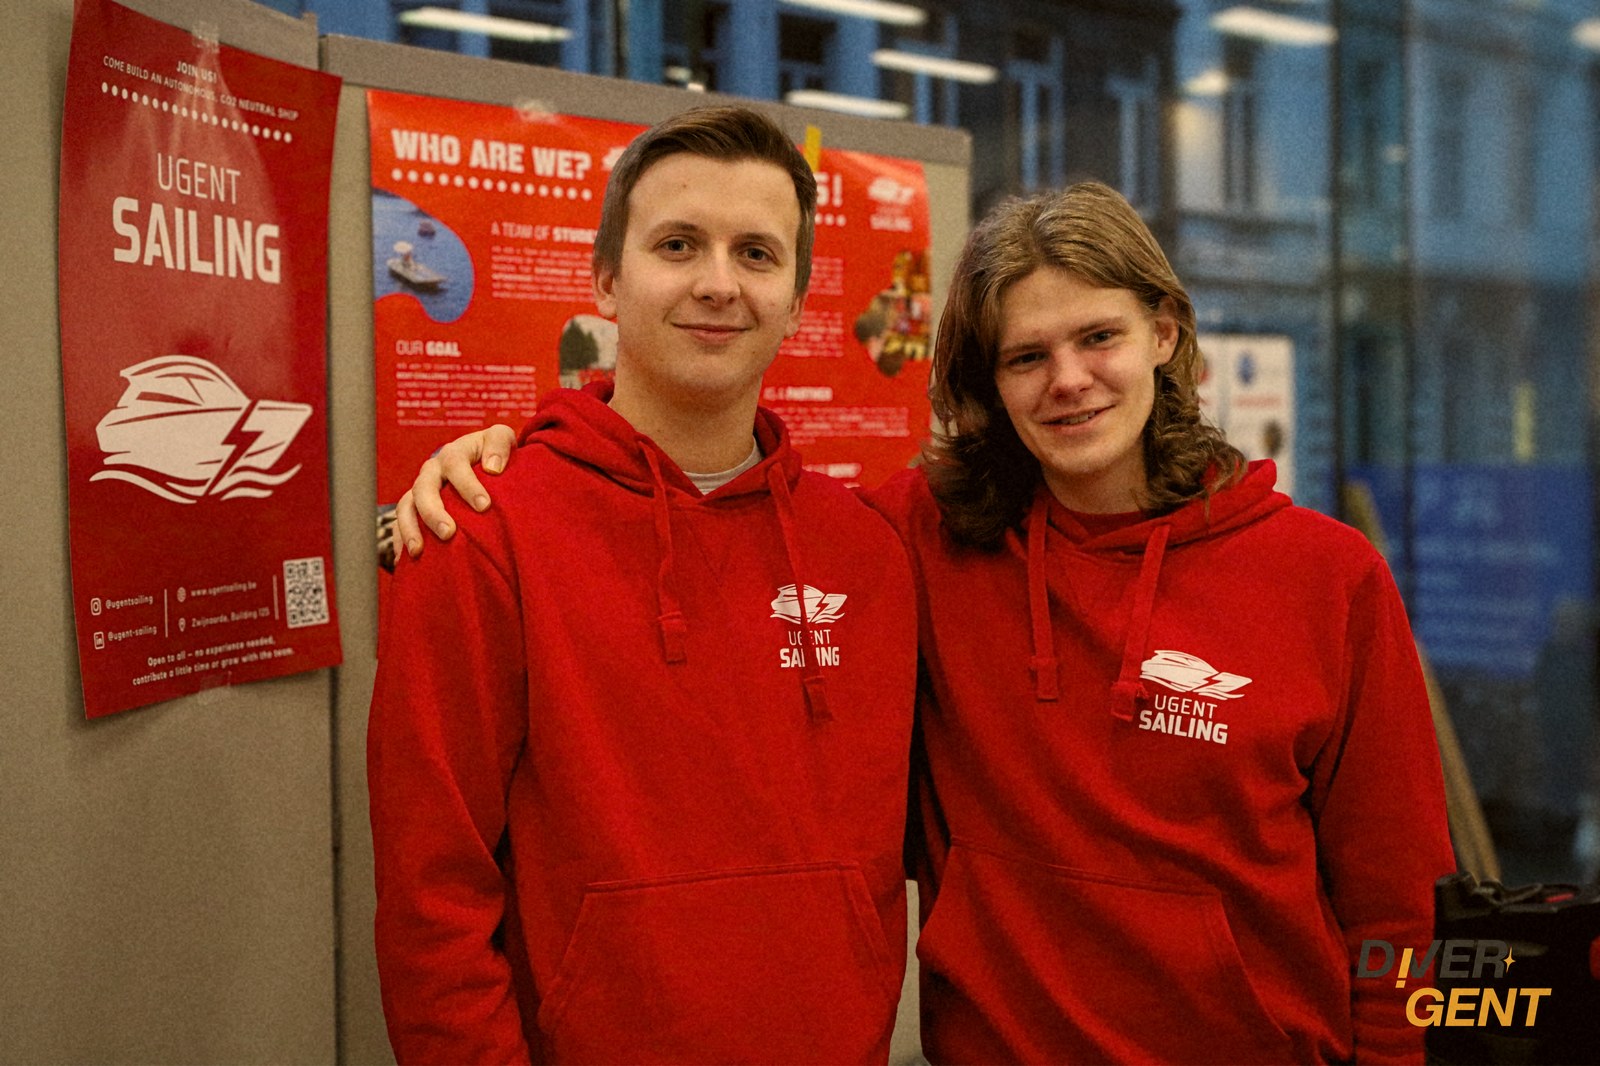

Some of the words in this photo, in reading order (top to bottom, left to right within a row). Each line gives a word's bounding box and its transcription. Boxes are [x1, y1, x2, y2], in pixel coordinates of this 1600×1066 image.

[176, 61, 199, 78] JOIN
[201, 68, 217, 84] US!
[103, 55, 125, 72] COME
[126, 63, 149, 80] BUILD
[151, 72, 162, 85] AN
[239, 98, 276, 117] NEUTRAL
[390, 129, 461, 166] WHO
[469, 138, 525, 174] ARE
[531, 146, 592, 181] WE?
[157, 153, 241, 205] UGENT
[112, 196, 281, 284] SAILING
[502, 222, 533, 239] TEAM
[396, 339, 424, 356] OUR
[105, 594, 154, 610] @ugentsailing
[108, 624, 158, 641] @ugent-sailing
[147, 656, 167, 667] Open
[167, 654, 175, 662] to
[176, 649, 186, 660] all
[194, 649, 204, 657] no
[205, 642, 245, 655] experience
[132, 672, 167, 686] contribute
[175, 664, 192, 676] little
[194, 662, 210, 672] time
[221, 657, 240, 669] grow
[241, 652, 259, 663] with
[259, 650, 273, 660] the
[1154, 694, 1218, 719] UGENT
[1138, 709, 1229, 745] SAILING
